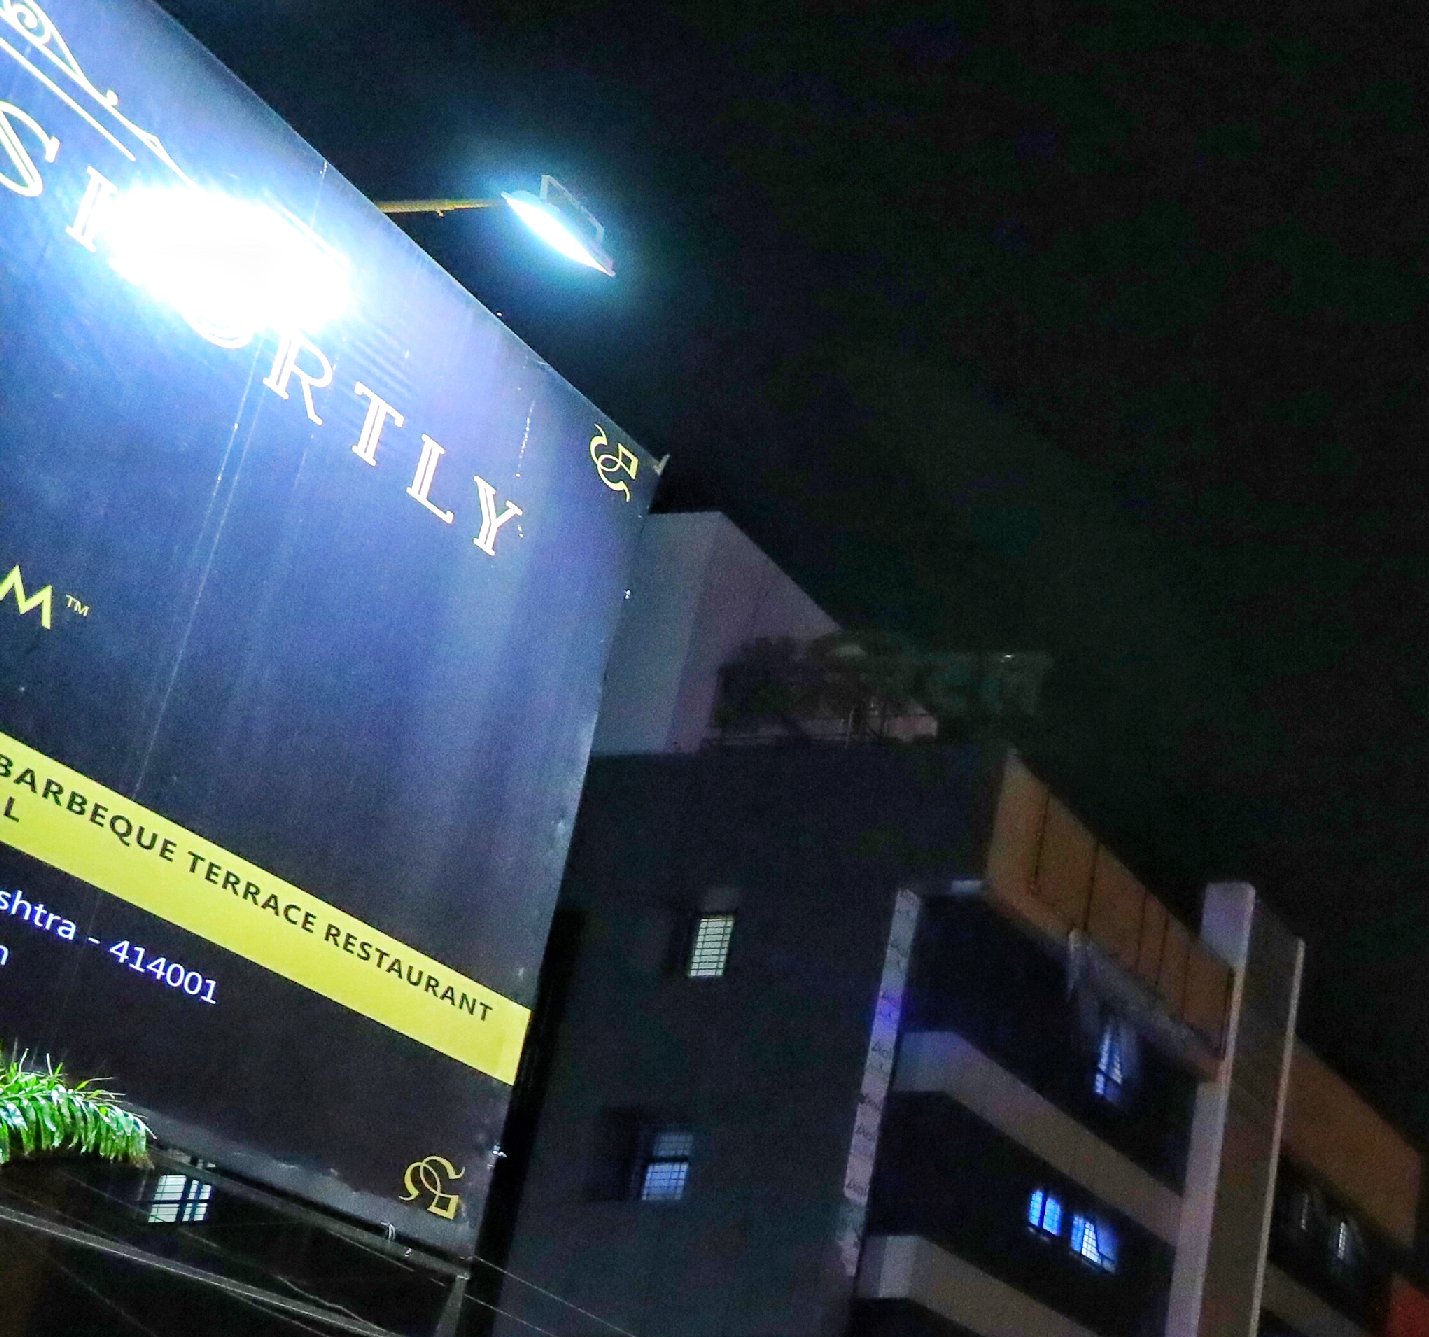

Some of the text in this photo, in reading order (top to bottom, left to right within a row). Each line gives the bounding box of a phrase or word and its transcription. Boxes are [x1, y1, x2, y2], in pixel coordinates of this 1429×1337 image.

[0, 103, 523, 556] SRTLY
[0, 753, 494, 1023] BARBEQUE TERRACE RESTAURANT
[109, 938, 218, 1005] 414001
